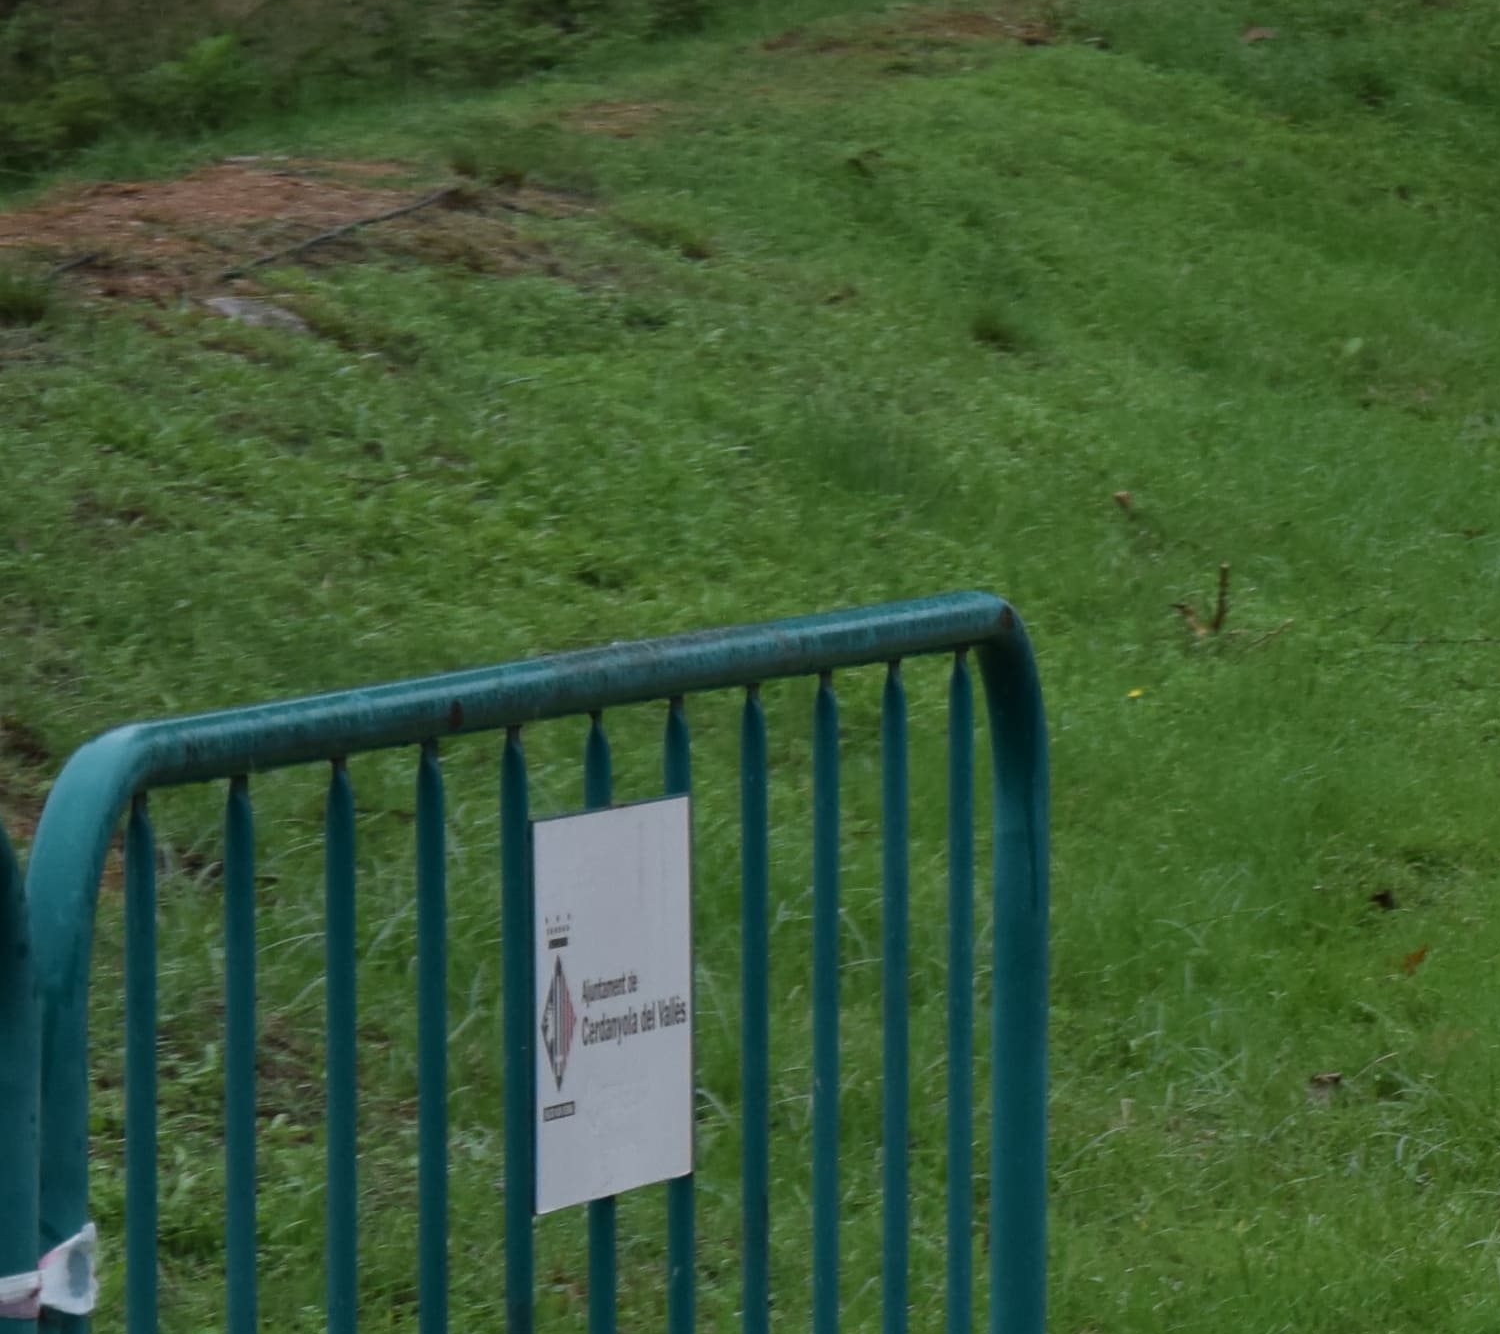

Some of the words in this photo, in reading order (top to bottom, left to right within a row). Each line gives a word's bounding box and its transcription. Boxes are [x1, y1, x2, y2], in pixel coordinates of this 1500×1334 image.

[582, 976, 626, 1008] Ajuntament
[628, 970, 638, 995] de
[582, 1008, 638, 1046] Cerdanyola
[641, 1002, 655, 1033] del
[657, 995, 686, 1028] Vallès
